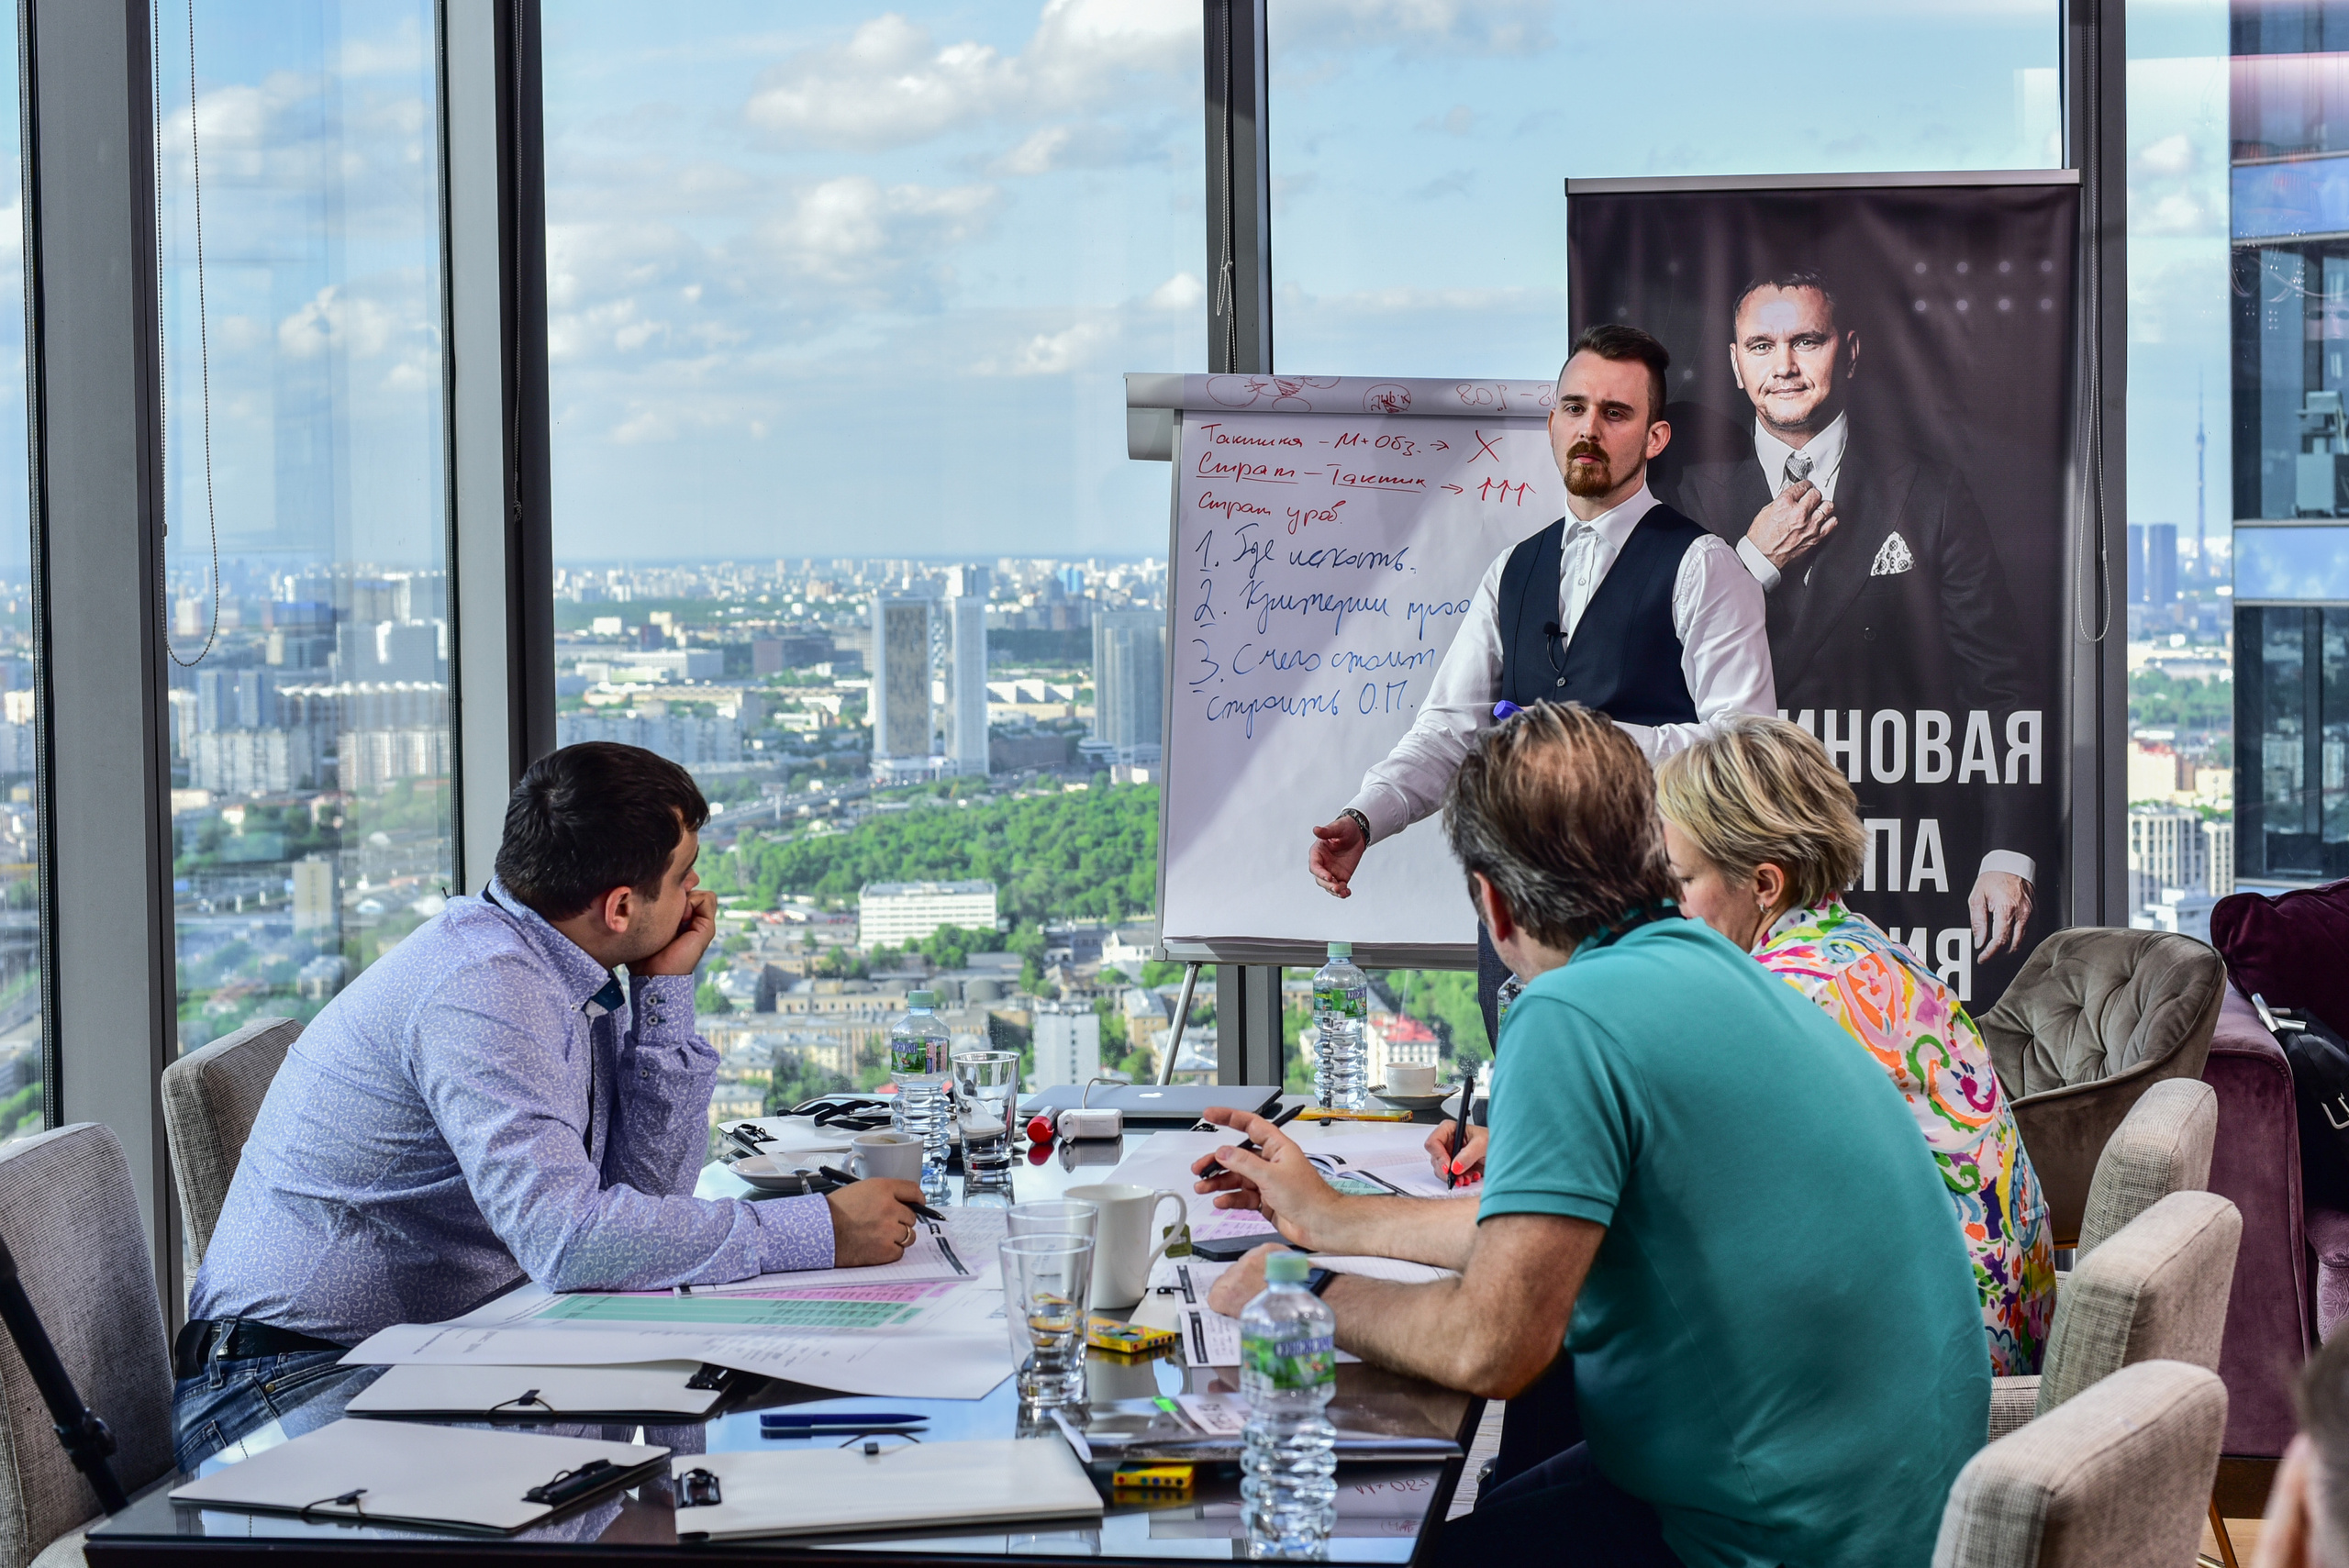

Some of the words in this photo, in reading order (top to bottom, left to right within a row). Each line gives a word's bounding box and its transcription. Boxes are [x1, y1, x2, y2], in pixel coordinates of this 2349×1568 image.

[1195, 529, 1219, 567] 1.
[1194, 579, 1227, 621] 2.
[1189, 638, 1224, 684] 3.
[1777, 709, 2042, 784] НОВАЯ
[1844, 818, 1949, 893] ПА
